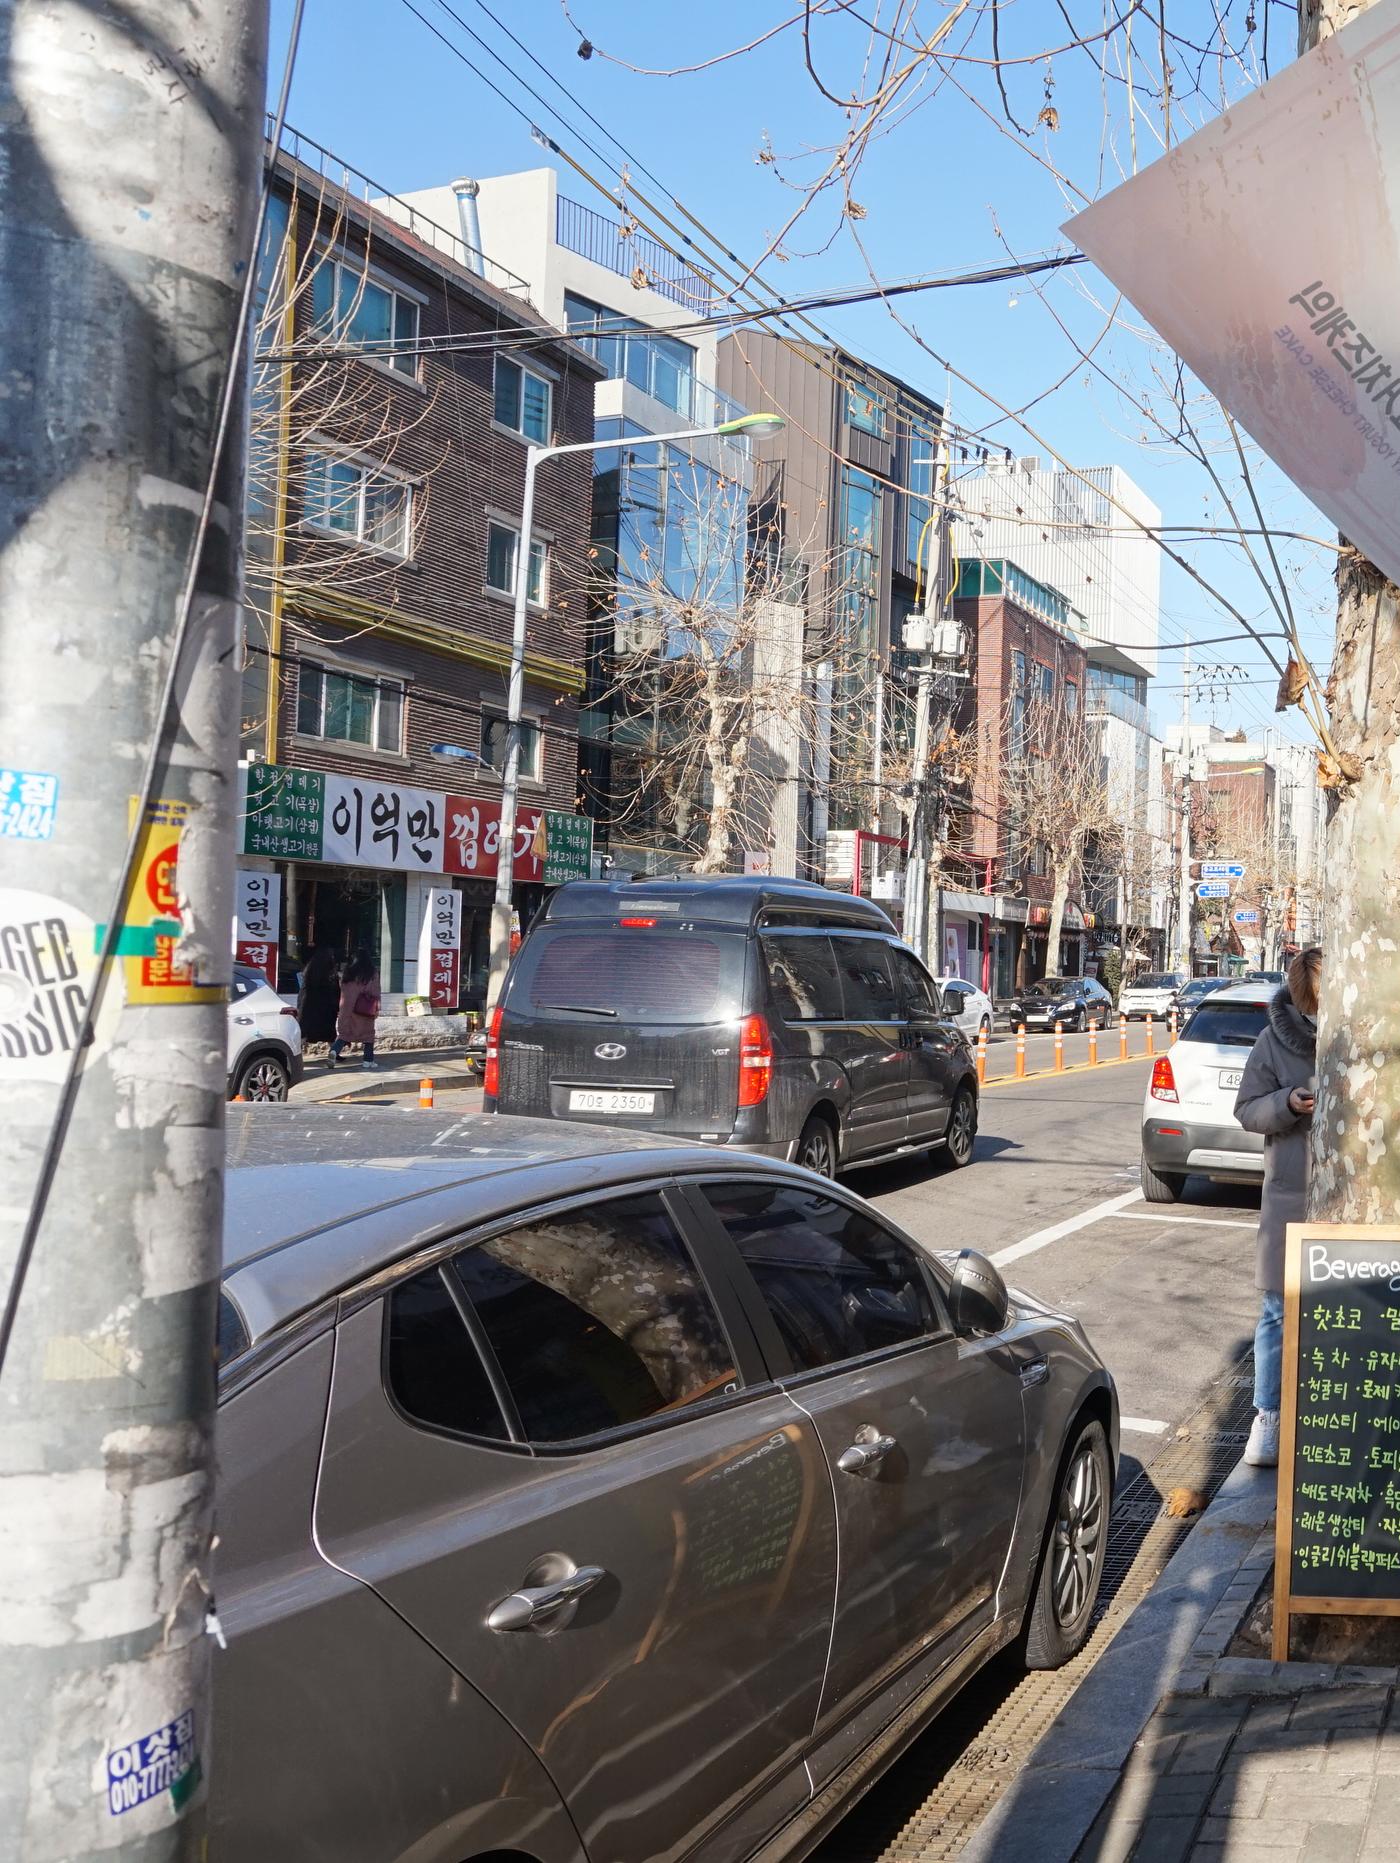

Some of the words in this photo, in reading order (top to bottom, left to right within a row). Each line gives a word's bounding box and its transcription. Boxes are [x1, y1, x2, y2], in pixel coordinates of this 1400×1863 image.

[332, 786, 440, 864] 이억만
[245, 878, 272, 938] 이억만
[435, 894, 456, 946] 이억만
[611, 1095, 646, 1109] 2350
[1313, 1304, 1361, 1331] 핫초코
[1303, 1412, 1357, 1433] 아이스티
[1303, 1444, 1351, 1466] 민트초코
